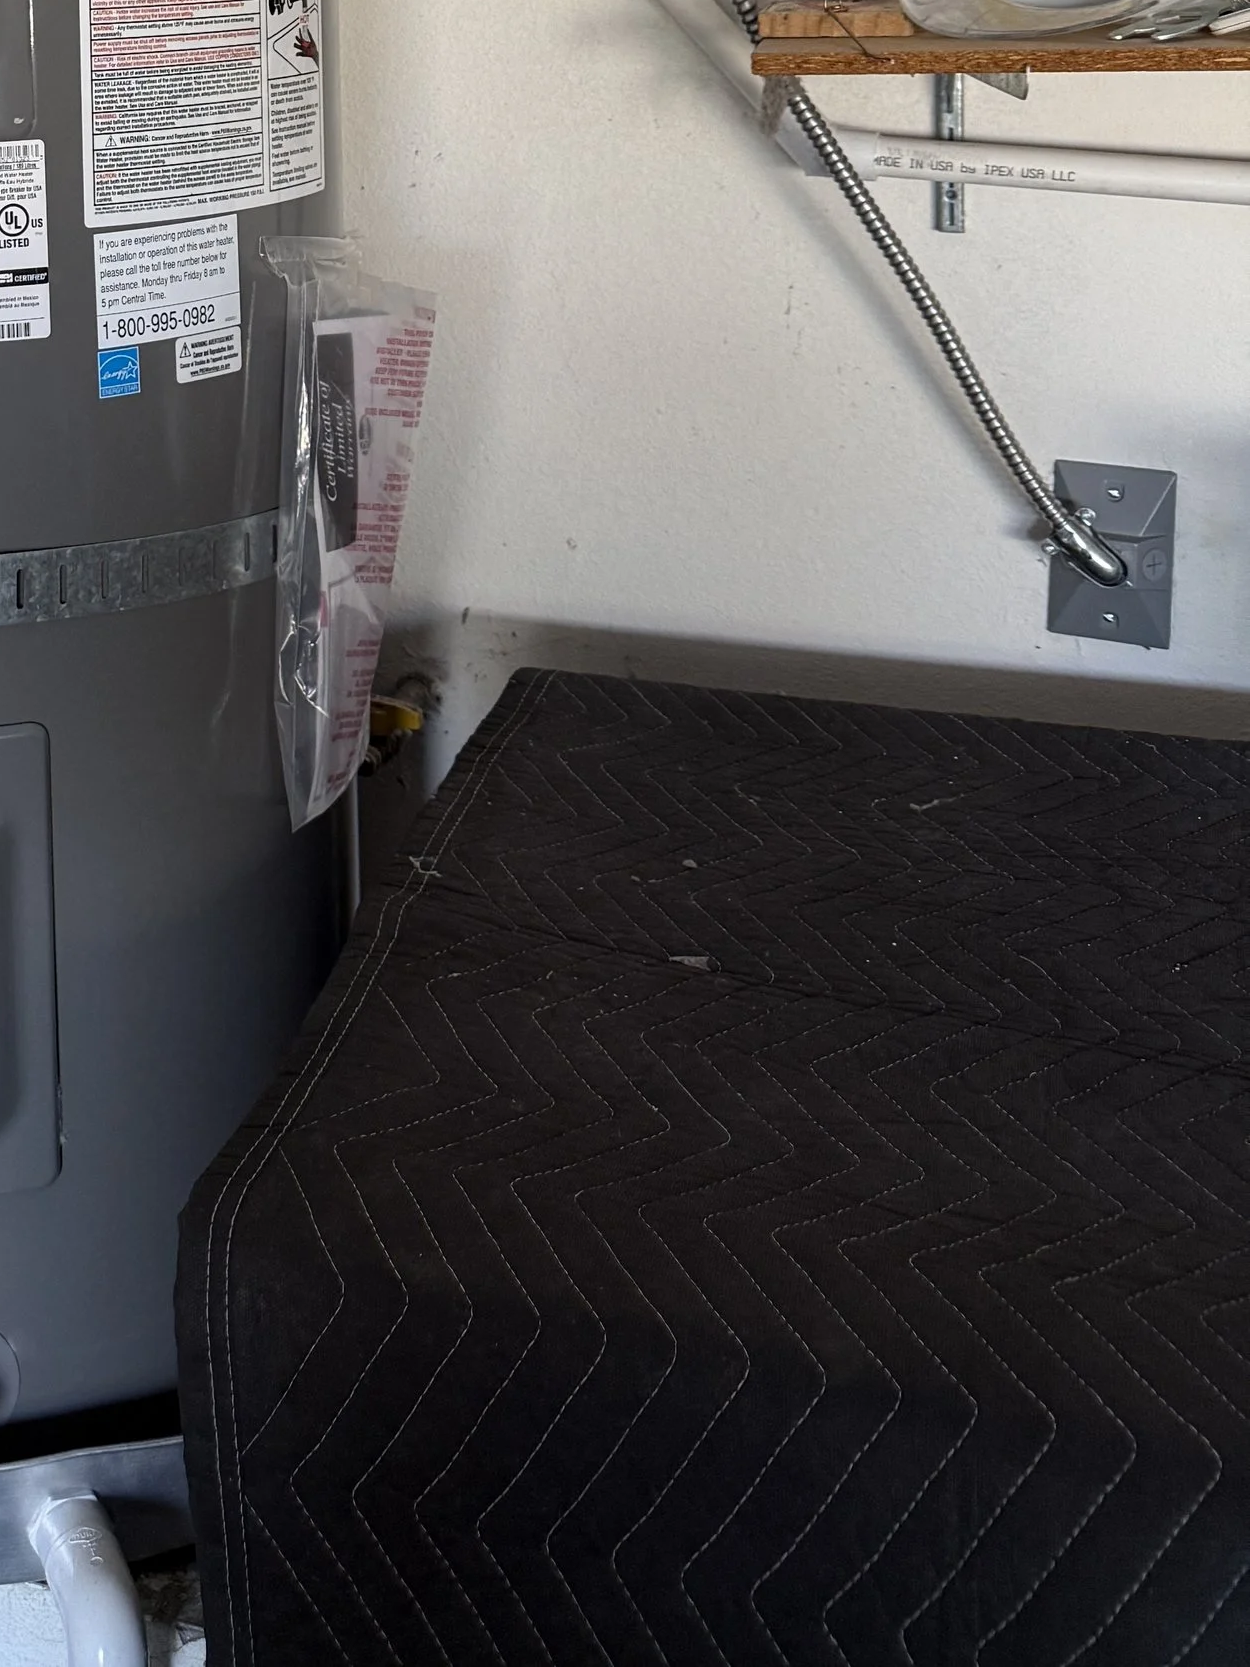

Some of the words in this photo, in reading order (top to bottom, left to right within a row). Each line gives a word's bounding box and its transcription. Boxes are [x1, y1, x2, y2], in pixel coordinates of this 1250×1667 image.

[300, 15, 309, 23] HOT
[119, 134, 150, 145] WARNING:
[909, 158, 923, 169] IN
[930, 160, 954, 172] USA
[961, 163, 976, 174] by
[984, 164, 1013, 177] IPEX
[1021, 167, 1045, 179] USA
[1052, 170, 1075, 182] LLC
[4, 211, 22, 230] UL
[31, 218, 43, 228] US
[99, 239, 104, 249] If
[105, 239, 119, 251] you
[120, 238, 132, 247] are
[134, 232, 176, 246] experiencing
[177, 226, 206, 240] problems
[206, 224, 218, 234] with
[219, 223, 228, 231] the
[99, 251, 138, 264] installation
[138, 250, 146, 259] or
[147, 244, 178, 258] operation
[179, 244, 186, 253] of
[186, 242, 197, 252] this
[198, 240, 215, 250] water
[216, 236, 235, 247] heater,
[14, 272, 46, 283] CERTIFIED
[100, 267, 124, 281] please
[125, 265, 138, 275] call
[139, 262, 150, 273] the
[151, 261, 161, 271] toll
[162, 260, 176, 270] free
[177, 256, 201, 268] number
[201, 252, 218, 264] below
[218, 251, 227, 260] for
[100, 281, 139, 294] assistance.
[141, 276, 168, 288] Monday
[169, 272, 182, 283] thru
[183, 269, 202, 282] Friday
[203, 268, 208, 277] 8
[208, 269, 218, 277] am
[219, 267, 226, 275] to
[101, 298, 107, 308] 5
[108, 298, 120, 309] pm
[121, 293, 146, 305] Central
[148, 291, 166, 301] Time.
[102, 304, 215, 340] 1-800-995-0982
[102, 386, 124, 395] ENERGY
[124, 384, 138, 392] STAR
[319, 380, 331, 398] of
[333, 402, 346, 474] Limited
[320, 399, 337, 502] Certificate
